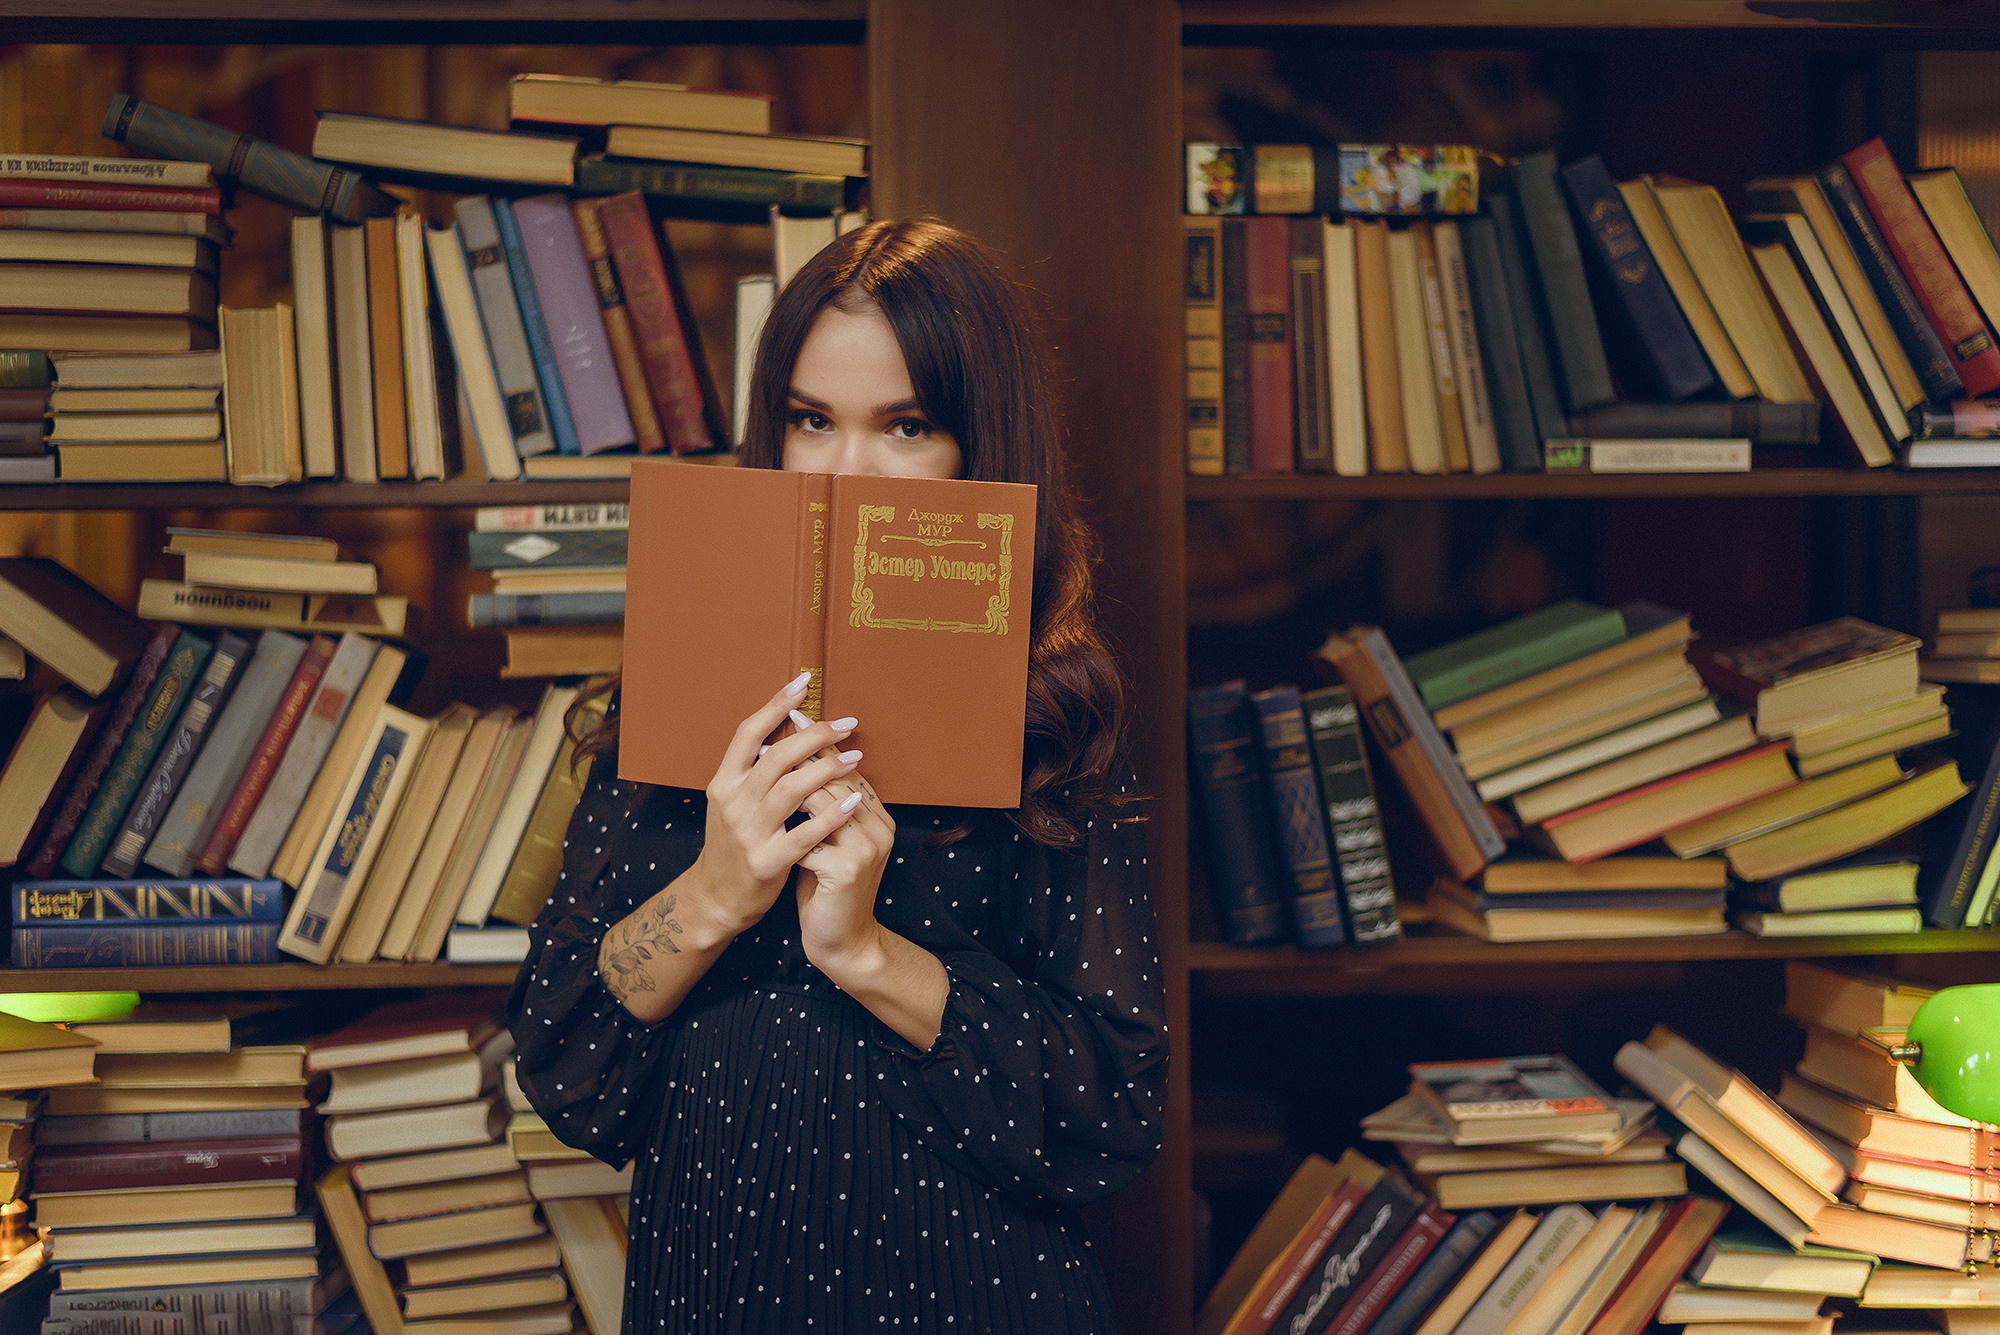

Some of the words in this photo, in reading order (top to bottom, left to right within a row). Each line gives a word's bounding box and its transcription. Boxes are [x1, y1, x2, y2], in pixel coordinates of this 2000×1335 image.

[26, 159, 90, 175] Последний
[907, 508, 964, 524] Джордж
[812, 518, 825, 554] МУР
[917, 523, 953, 537] МУР
[868, 551, 926, 582] Эстер
[930, 555, 997, 586] Уотерс
[809, 560, 824, 616] Джордж
[185, 1151, 219, 1169] Борис
